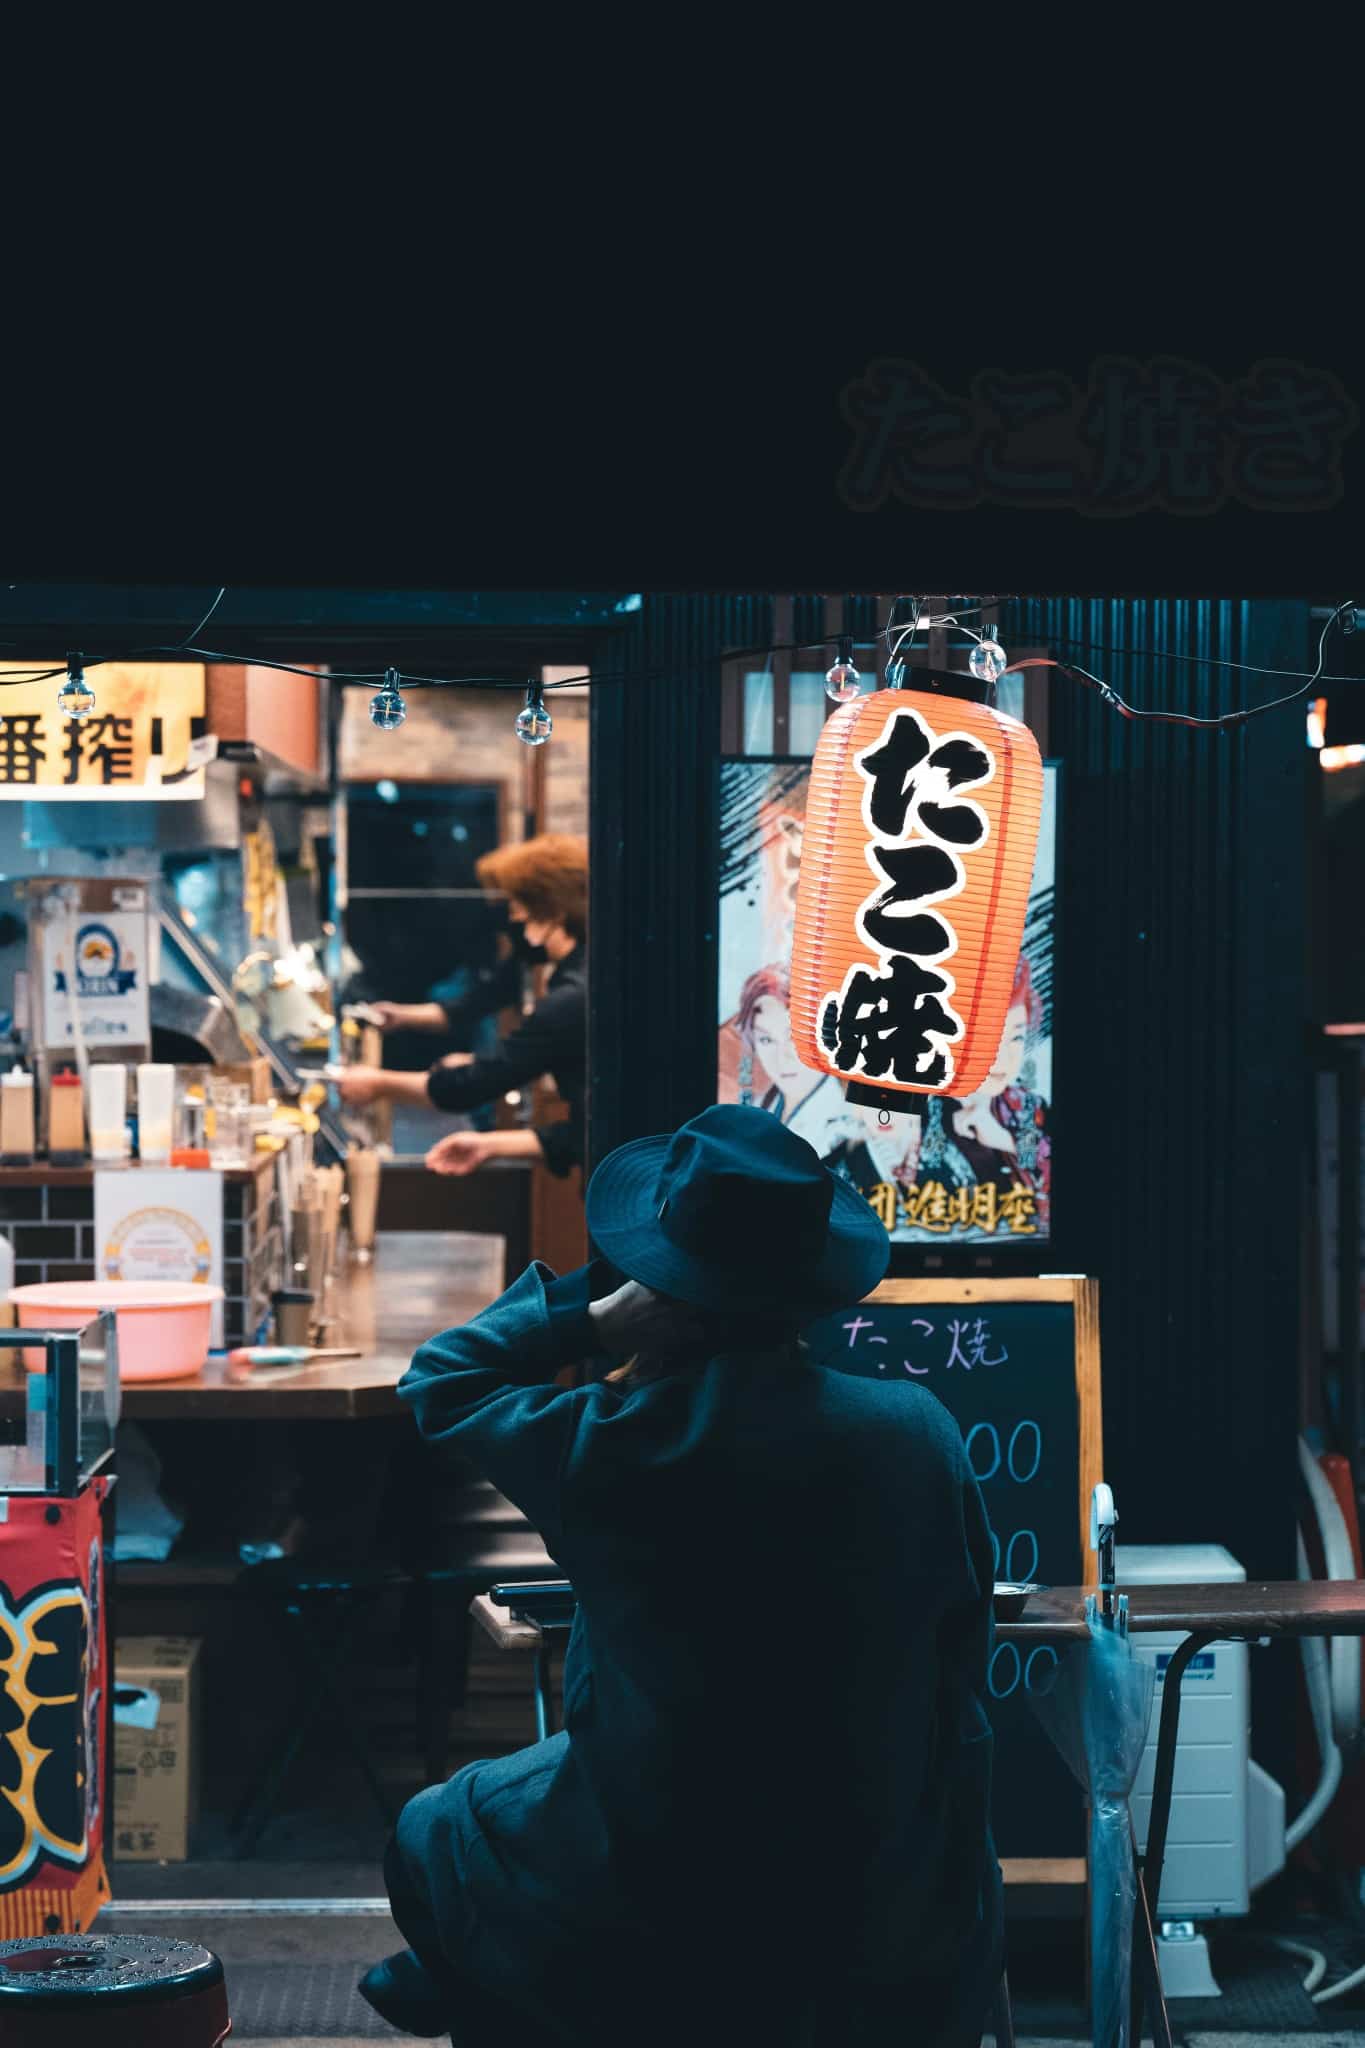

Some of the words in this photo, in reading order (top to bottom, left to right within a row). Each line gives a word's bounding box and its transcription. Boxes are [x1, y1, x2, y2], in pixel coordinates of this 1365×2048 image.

[853, 365, 1346, 505] たこ焼き
[819, 711, 992, 1088] たこ焼
[841, 1315, 1009, 1375] たこ焼
